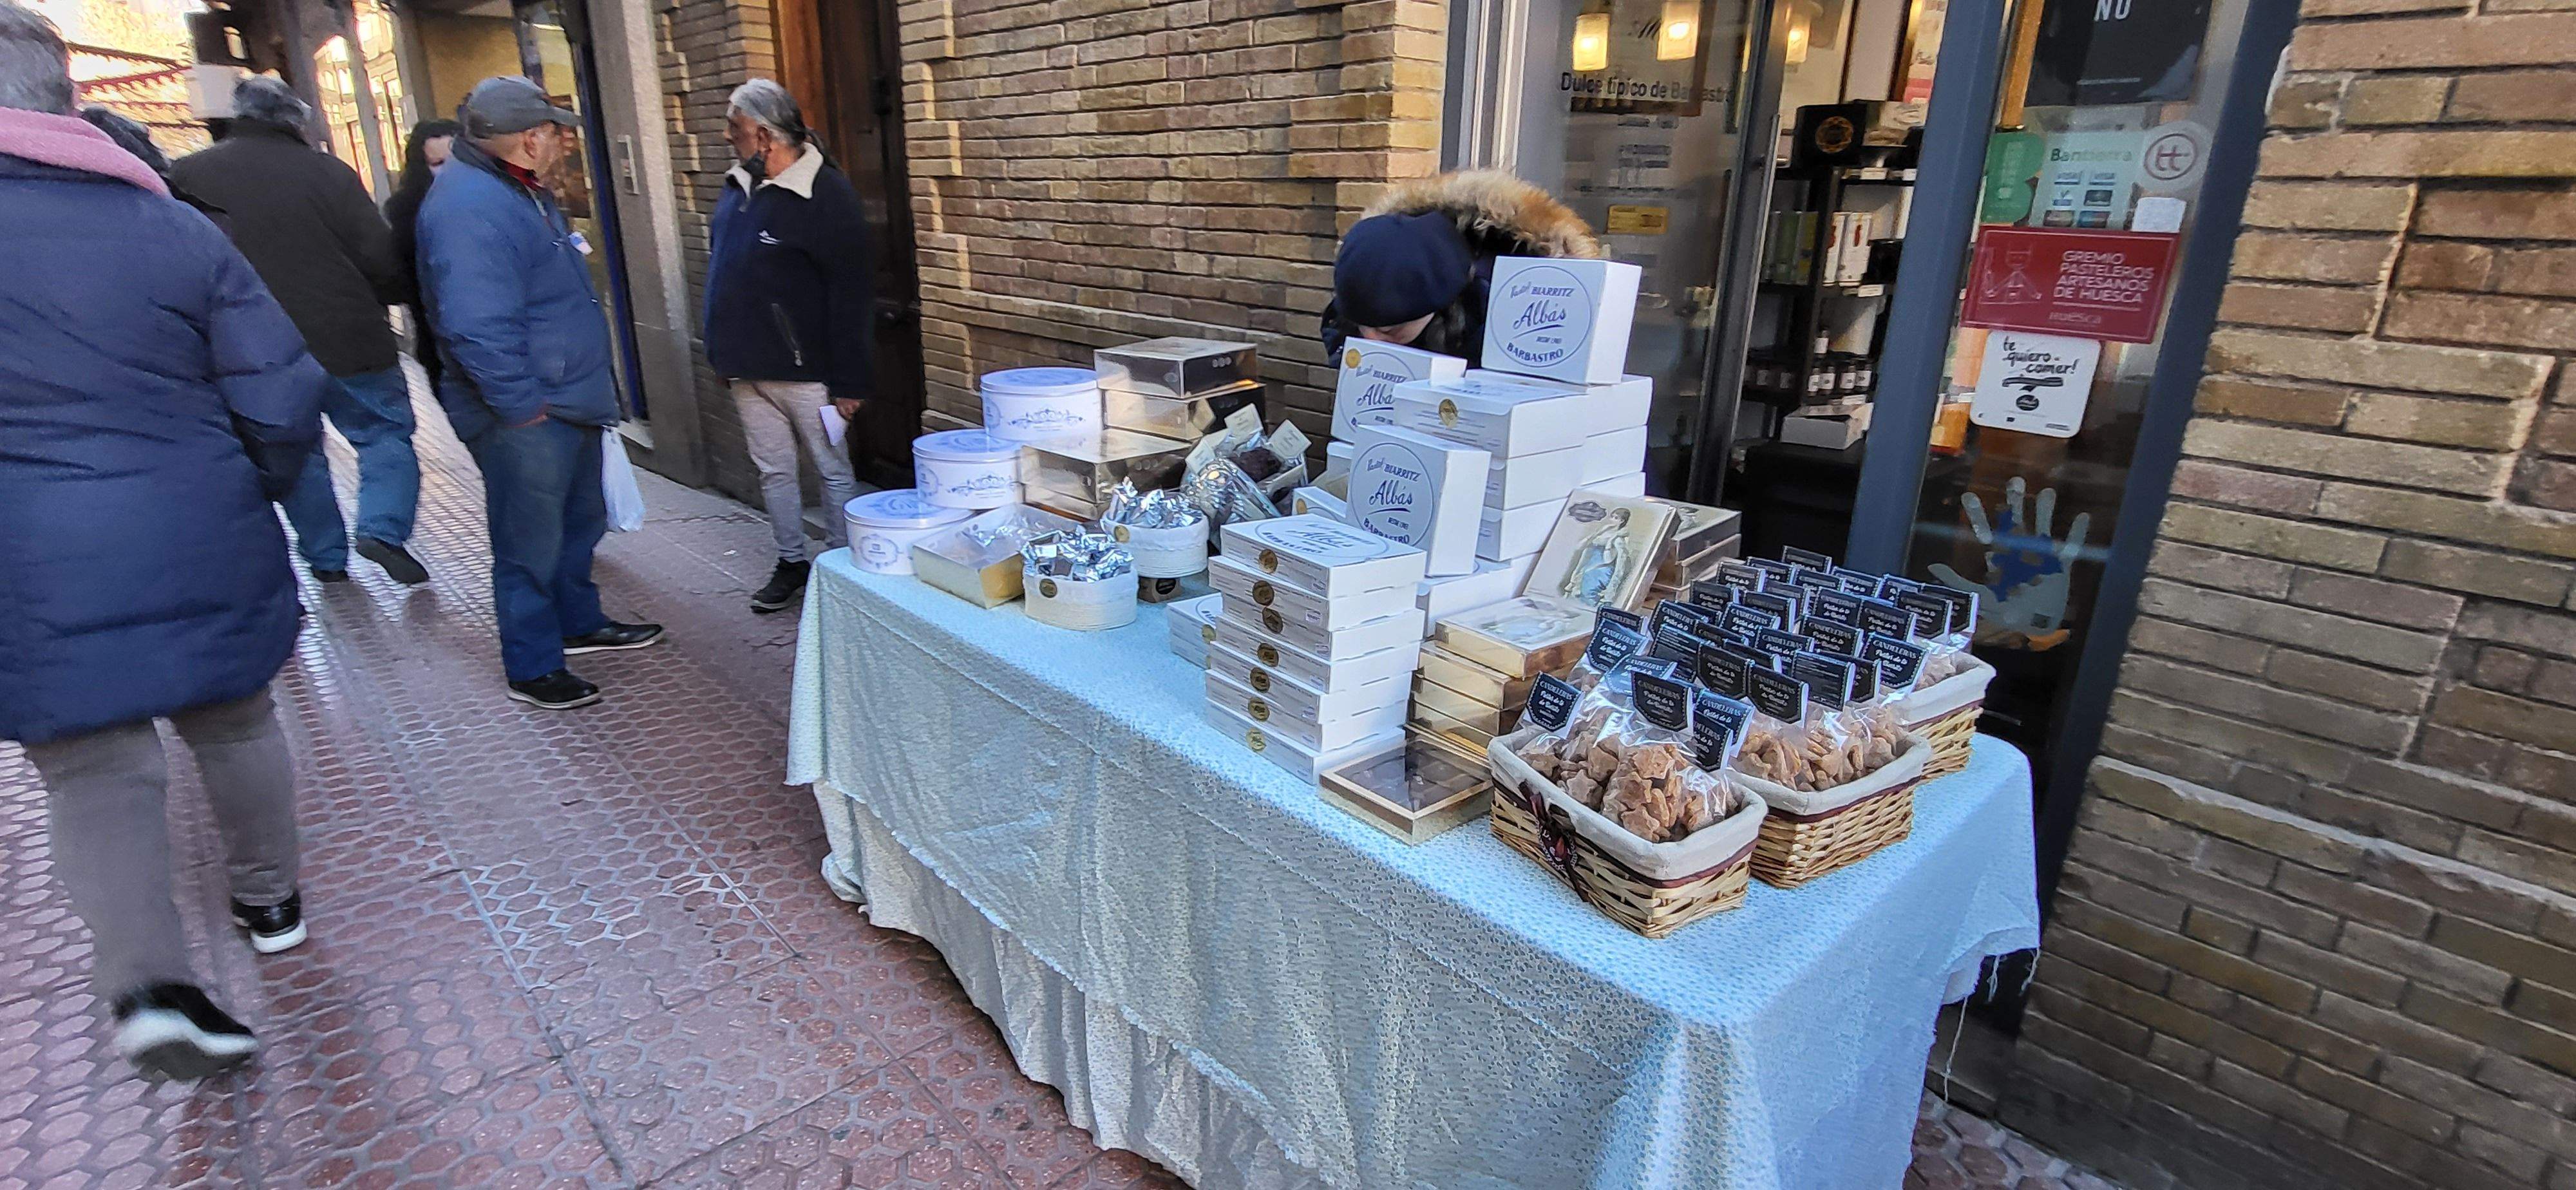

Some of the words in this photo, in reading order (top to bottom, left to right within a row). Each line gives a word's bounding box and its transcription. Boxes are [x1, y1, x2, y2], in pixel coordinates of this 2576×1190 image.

[1560, 71, 1603, 94] Dulce
[1607, 75, 1647, 97] típico
[1650, 80, 1667, 98] de
[2063, 250, 2125, 265] GREMIO
[2060, 262, 2155, 279] PASTELEROS
[1530, 286, 1575, 298] BIARRITZ
[2056, 275, 2149, 292] ARTESANOS
[2053, 287, 2075, 299] DE
[2079, 289, 2143, 303] HUESCA
[1513, 299, 1567, 330] Albás
[1506, 342, 1564, 363] BARBASTRO
[2003, 336, 2016, 351] te
[1356, 383, 1395, 406] Albá
[1383, 463, 1422, 482] BIARRITZ
[1368, 479, 1413, 505] Albás
[1873, 639, 1917, 659] CANDELERAS
[1701, 698, 1742, 717] CANDELERAS
